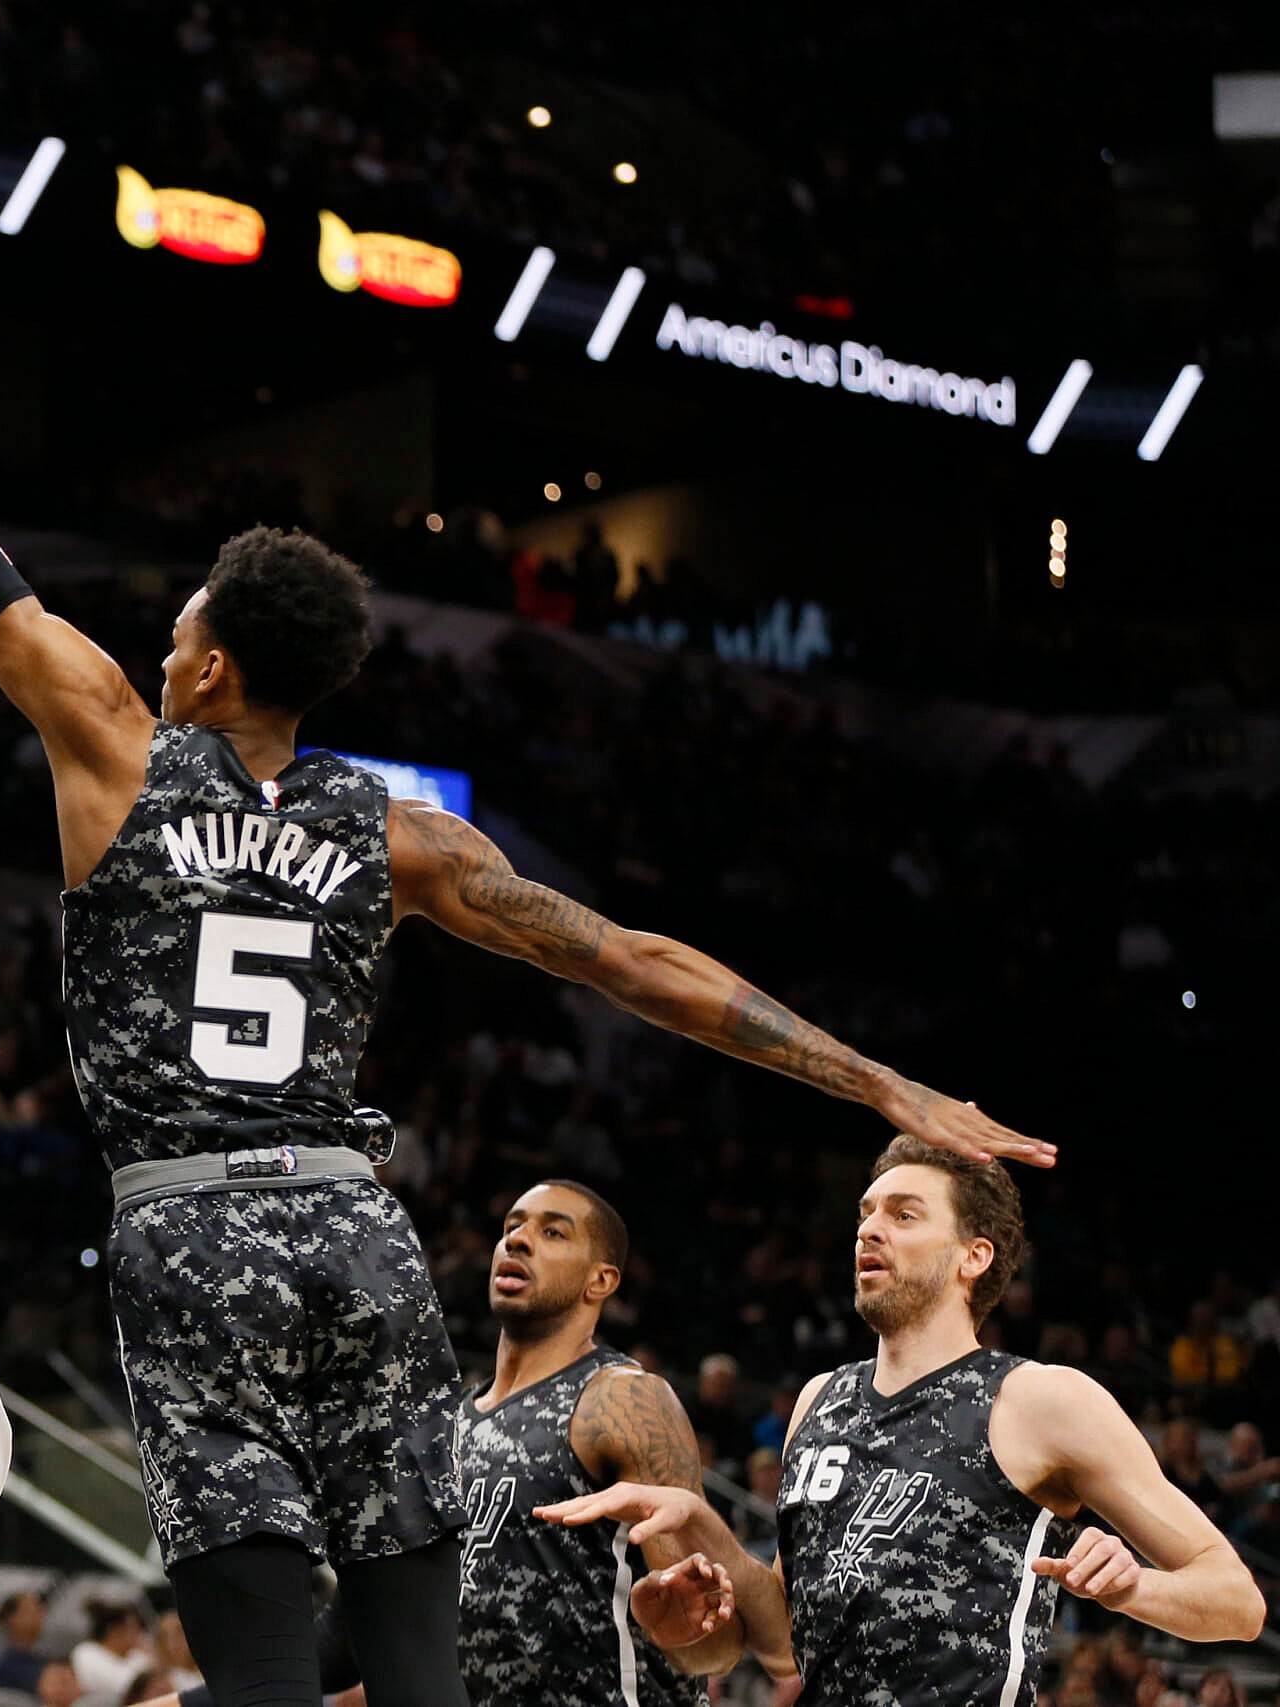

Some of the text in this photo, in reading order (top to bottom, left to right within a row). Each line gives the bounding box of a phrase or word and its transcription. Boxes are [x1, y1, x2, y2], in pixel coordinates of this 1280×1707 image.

[656, 302, 1016, 427] Americus Diamond
[160, 812, 363, 904] MURRAY
[189, 911, 315, 1085] 5
[785, 1444, 851, 1505] 16
